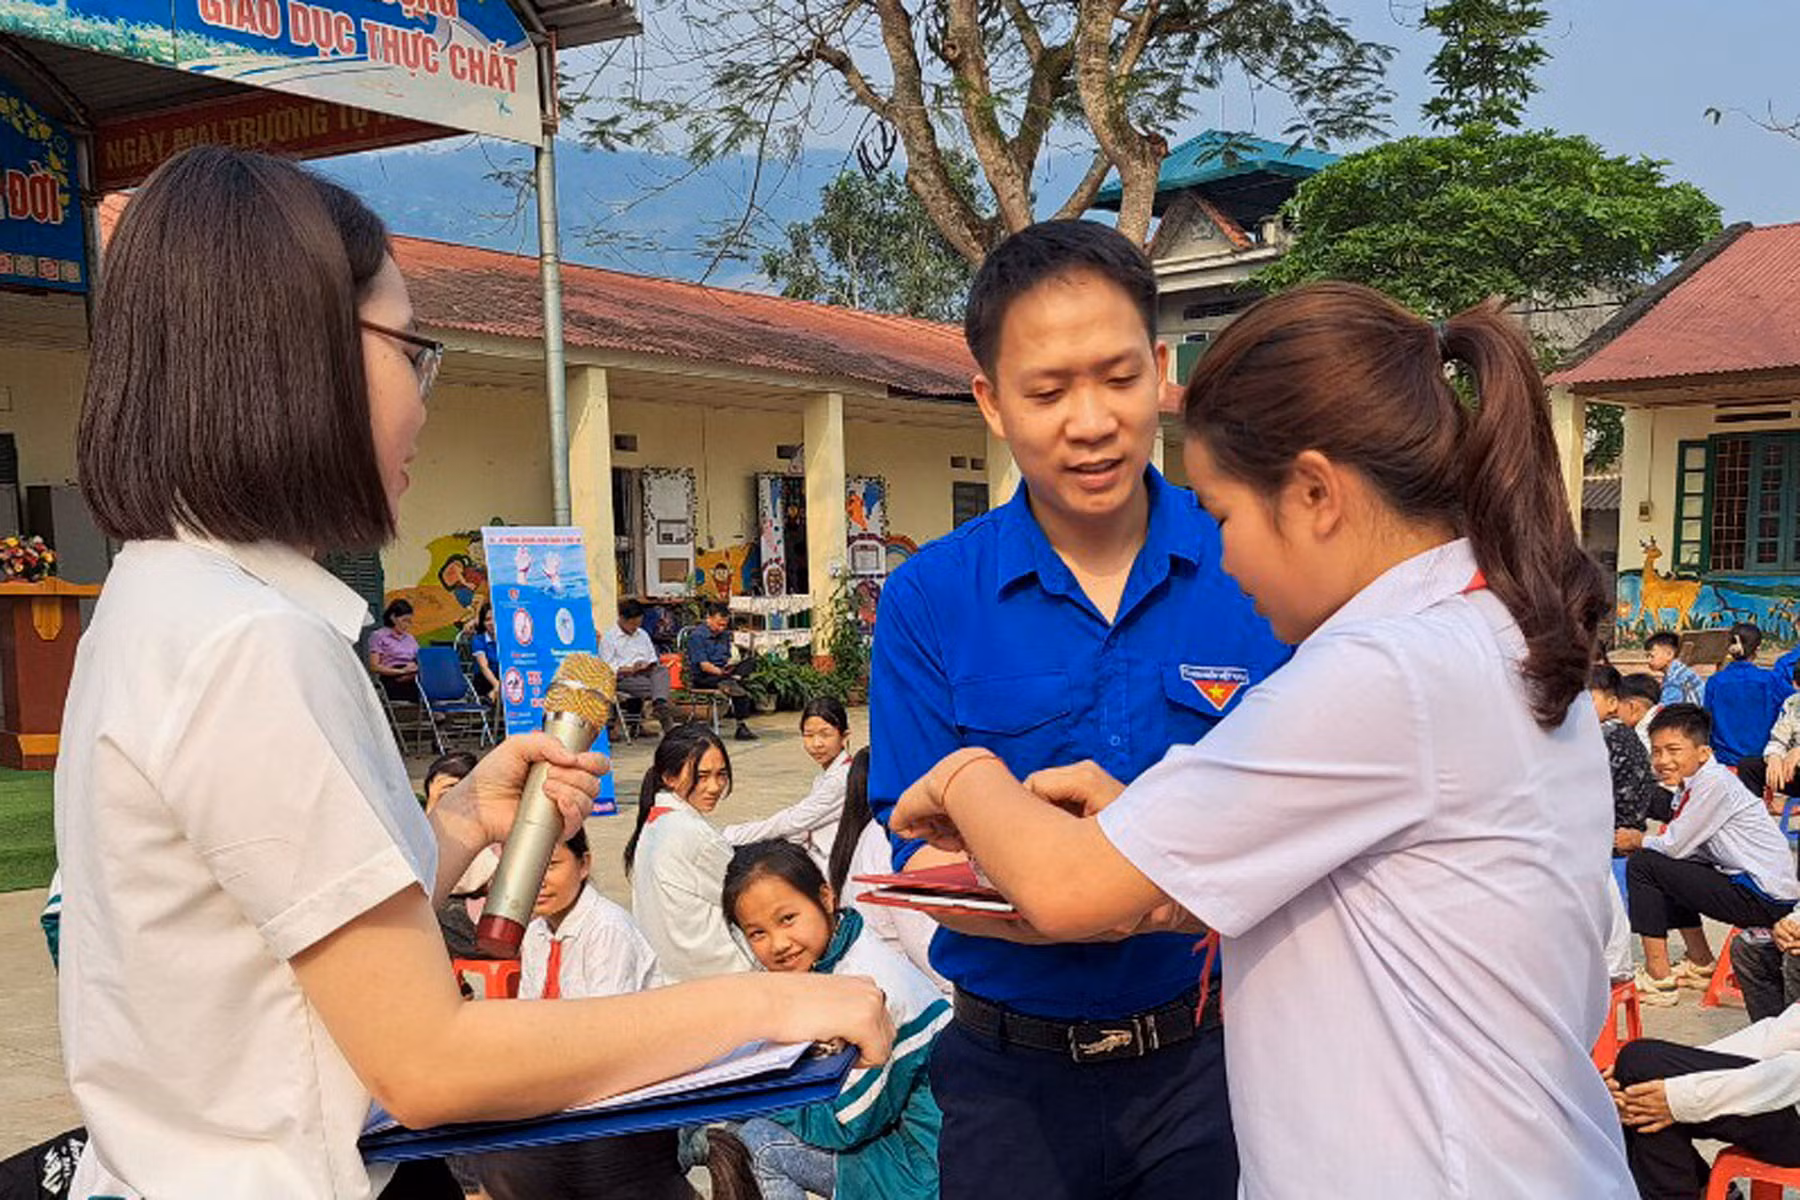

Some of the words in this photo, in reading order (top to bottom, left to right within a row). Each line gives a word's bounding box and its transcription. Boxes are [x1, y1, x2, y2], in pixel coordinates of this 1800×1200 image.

[289, 2, 357, 58] DỤC
[362, 20, 440, 78] THỰC
[449, 39, 518, 93] CHẤT
